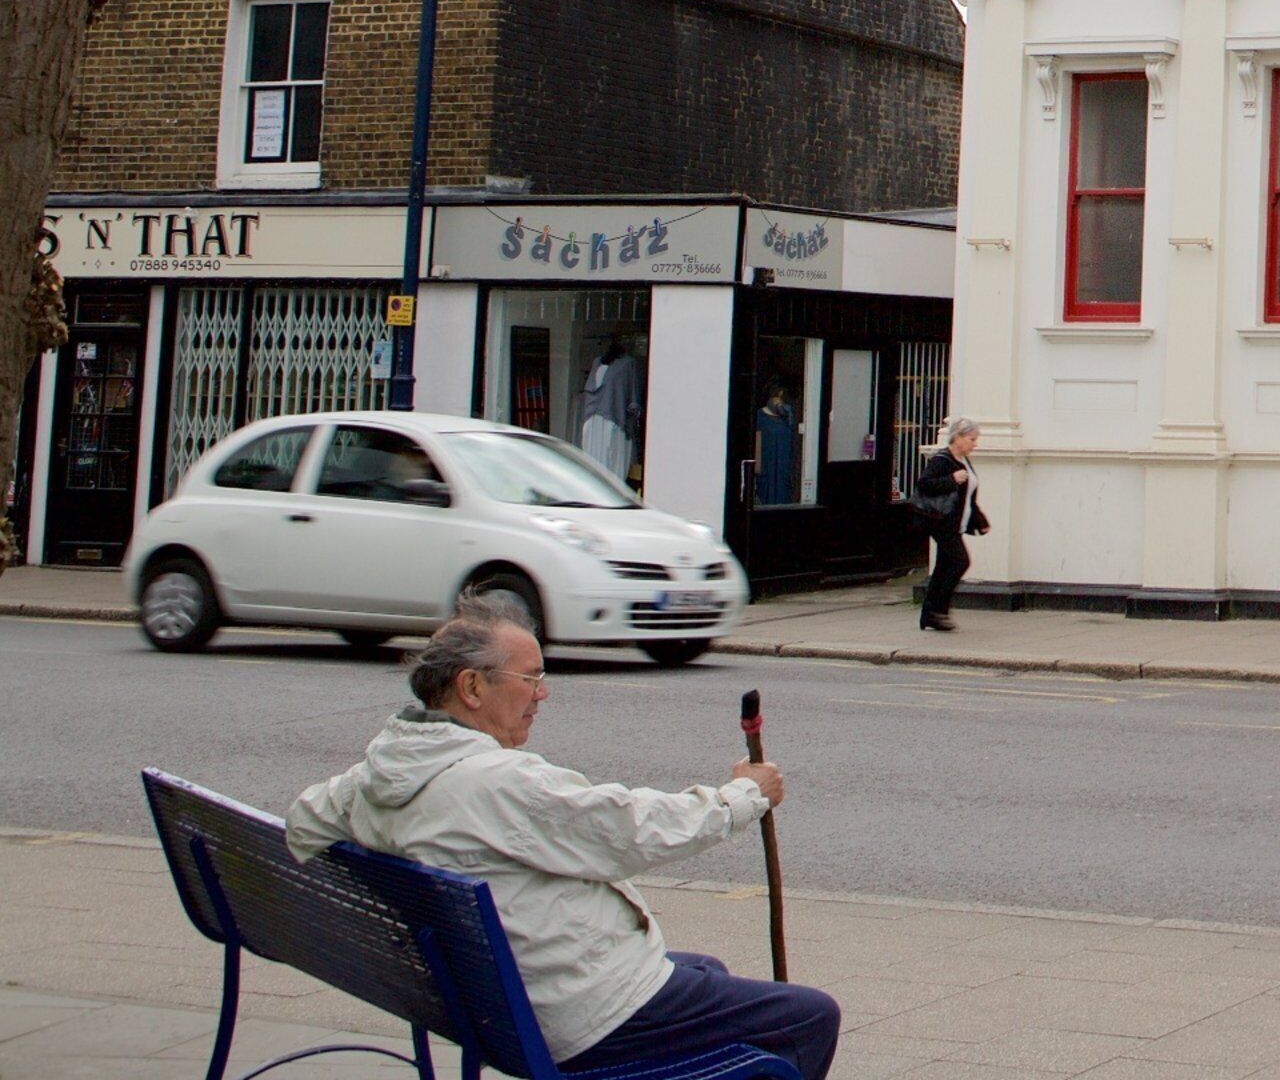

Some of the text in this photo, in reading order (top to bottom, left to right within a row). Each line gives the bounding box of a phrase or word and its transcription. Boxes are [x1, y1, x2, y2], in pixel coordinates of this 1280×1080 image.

[131, 211, 260, 258] THAT
[130, 259, 221, 272] 07888 945340
